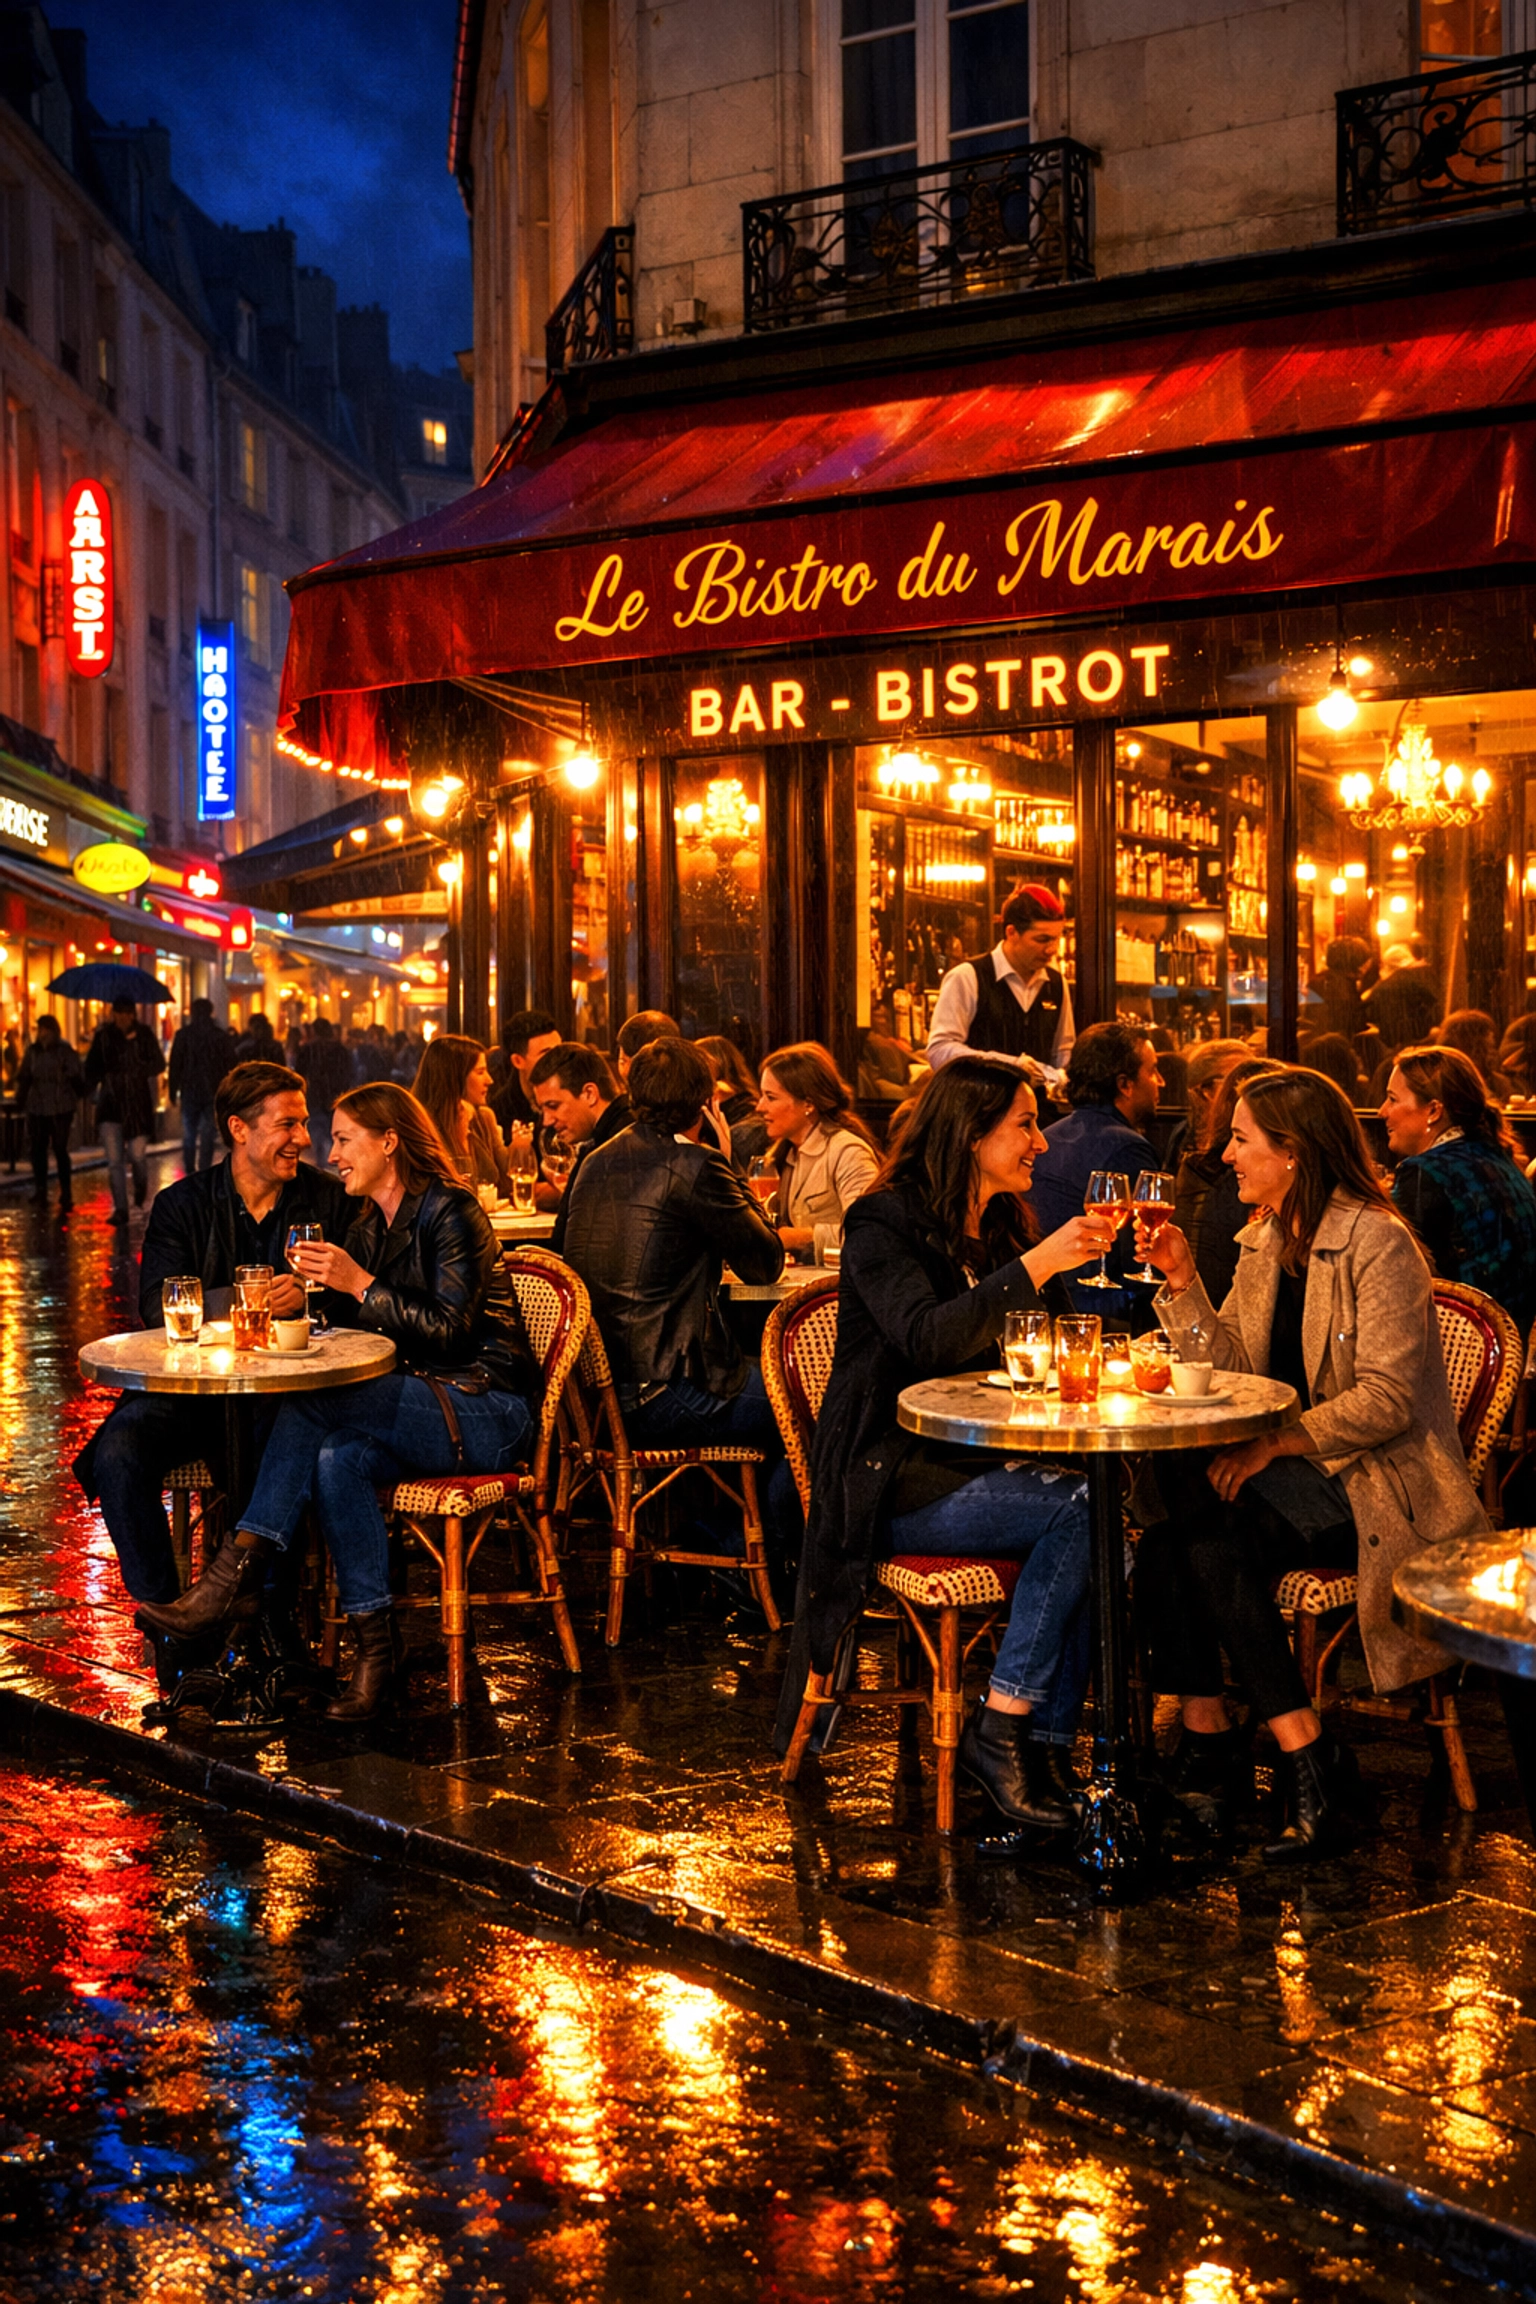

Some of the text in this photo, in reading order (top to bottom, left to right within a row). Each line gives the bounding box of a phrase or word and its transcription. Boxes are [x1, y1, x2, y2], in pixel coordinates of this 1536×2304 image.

[555, 497, 1284, 642] Le Bistro du Marais
[690, 680, 805, 736] BAR
[876, 645, 1170, 722] BISTROT
